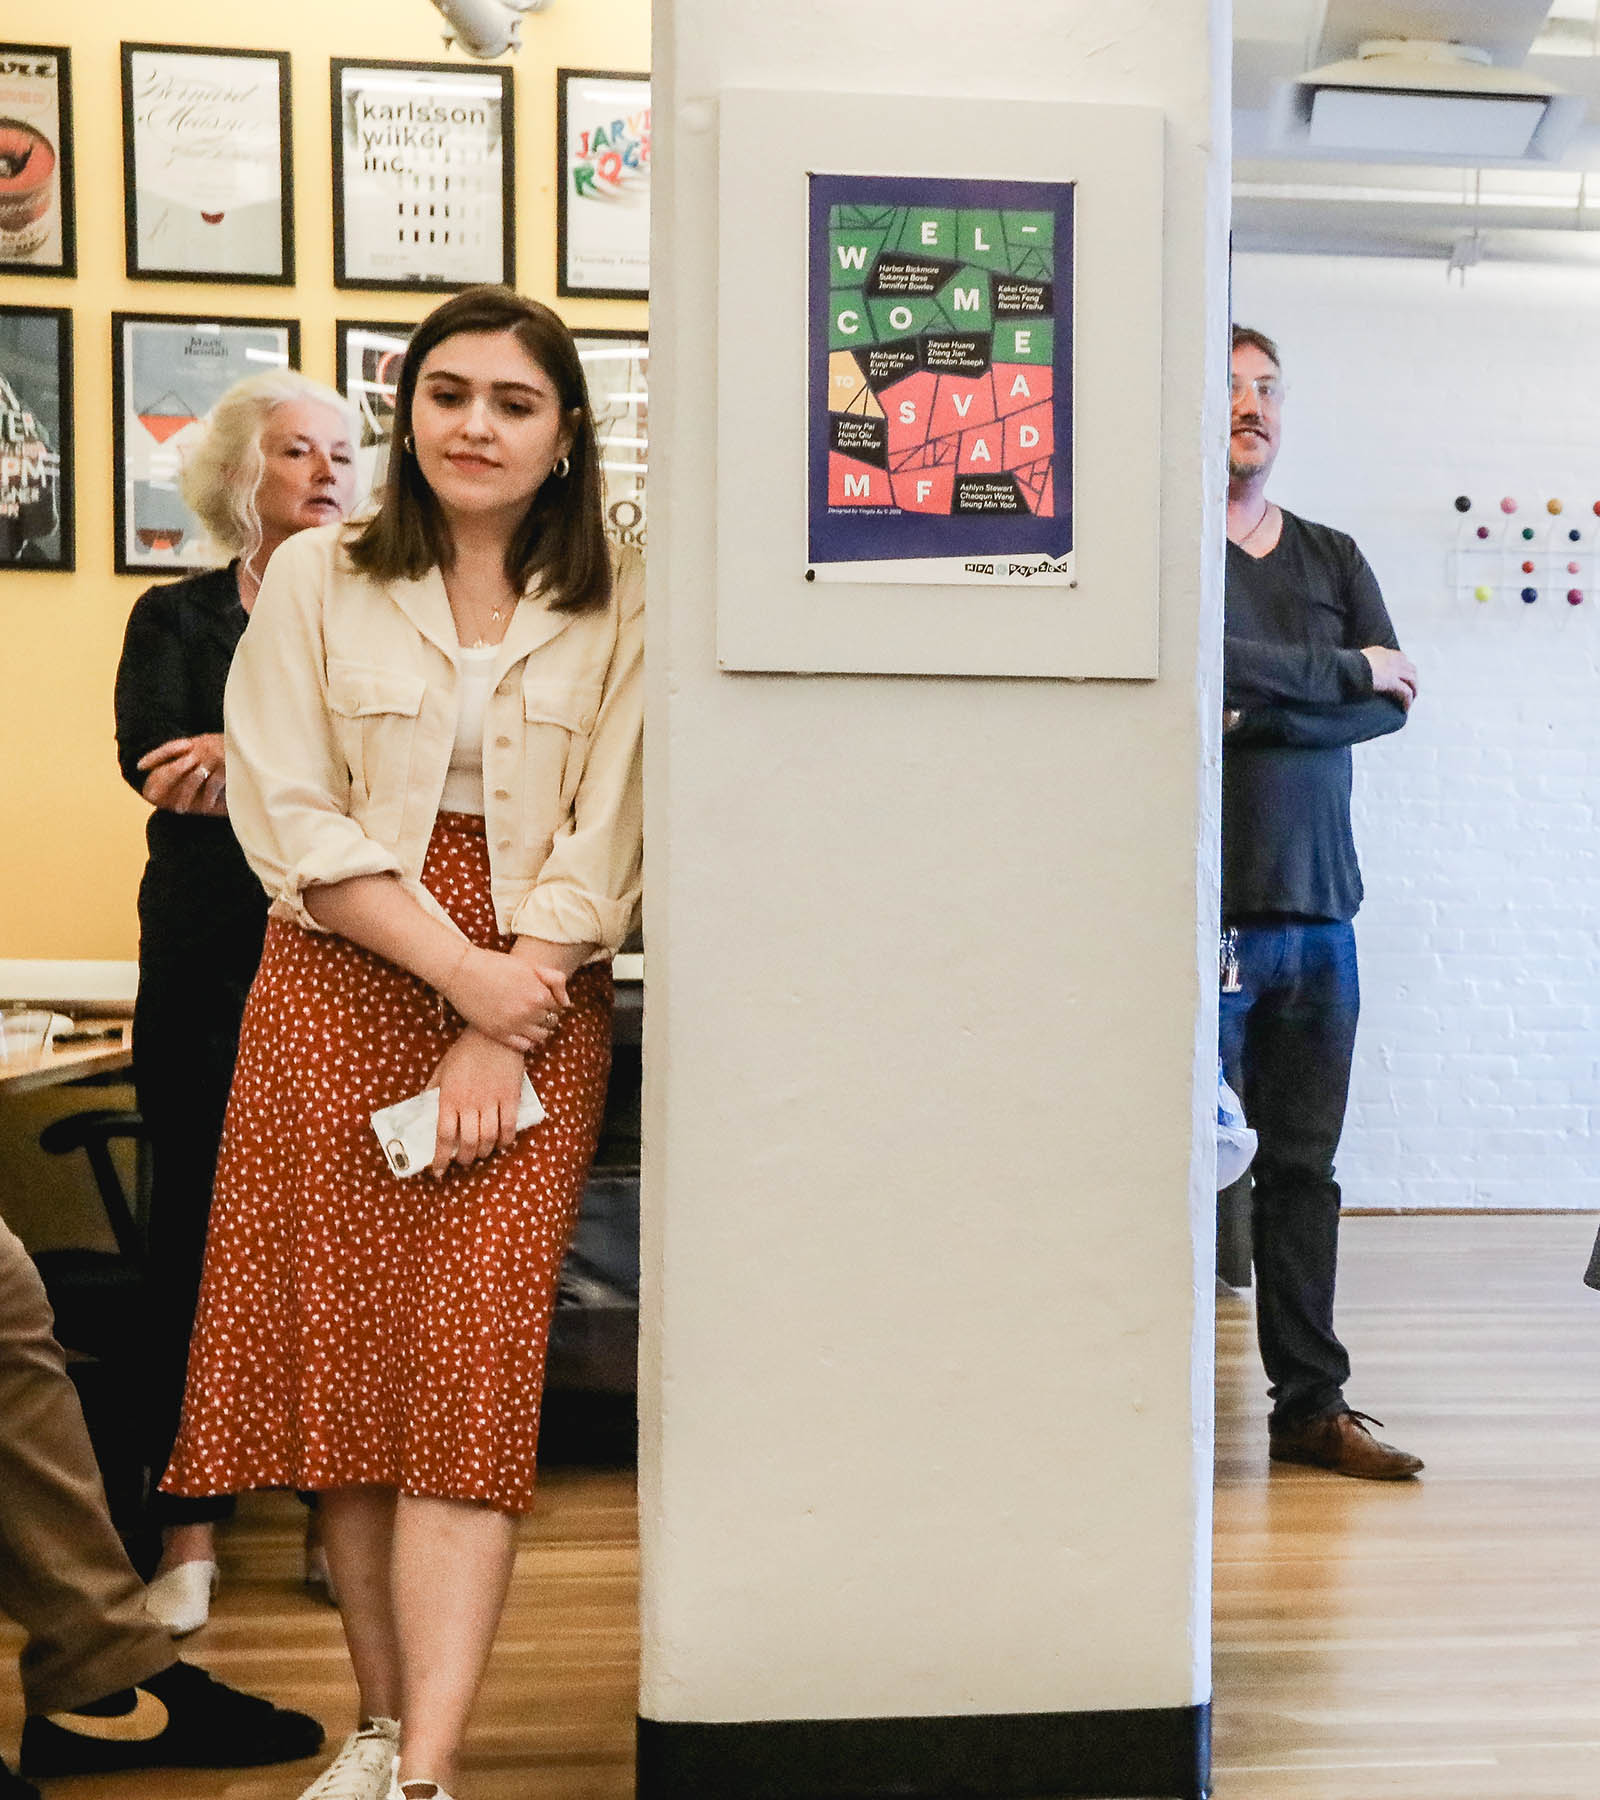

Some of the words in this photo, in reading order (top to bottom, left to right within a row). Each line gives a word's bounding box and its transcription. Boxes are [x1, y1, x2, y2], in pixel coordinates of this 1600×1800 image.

[363, 102, 485, 125] karlsson
[363, 127, 444, 151] wilker
[364, 152, 412, 173] inc.
[879, 281, 907, 289] Jennifer
[908, 282, 934, 291] Bowles
[951, 341, 975, 351] Huang
[870, 351, 898, 360] Michael
[889, 361, 904, 369] Kim
[927, 357, 957, 366] Brandon
[959, 359, 984, 367] Joseph
[839, 421, 863, 431] Tiffany
[838, 438, 861, 447] Rohan
[960, 483, 985, 492] Ashlyn
[985, 484, 1013, 492] Stewart
[960, 500, 983, 510] Seung
[999, 501, 1017, 509] Yoon
